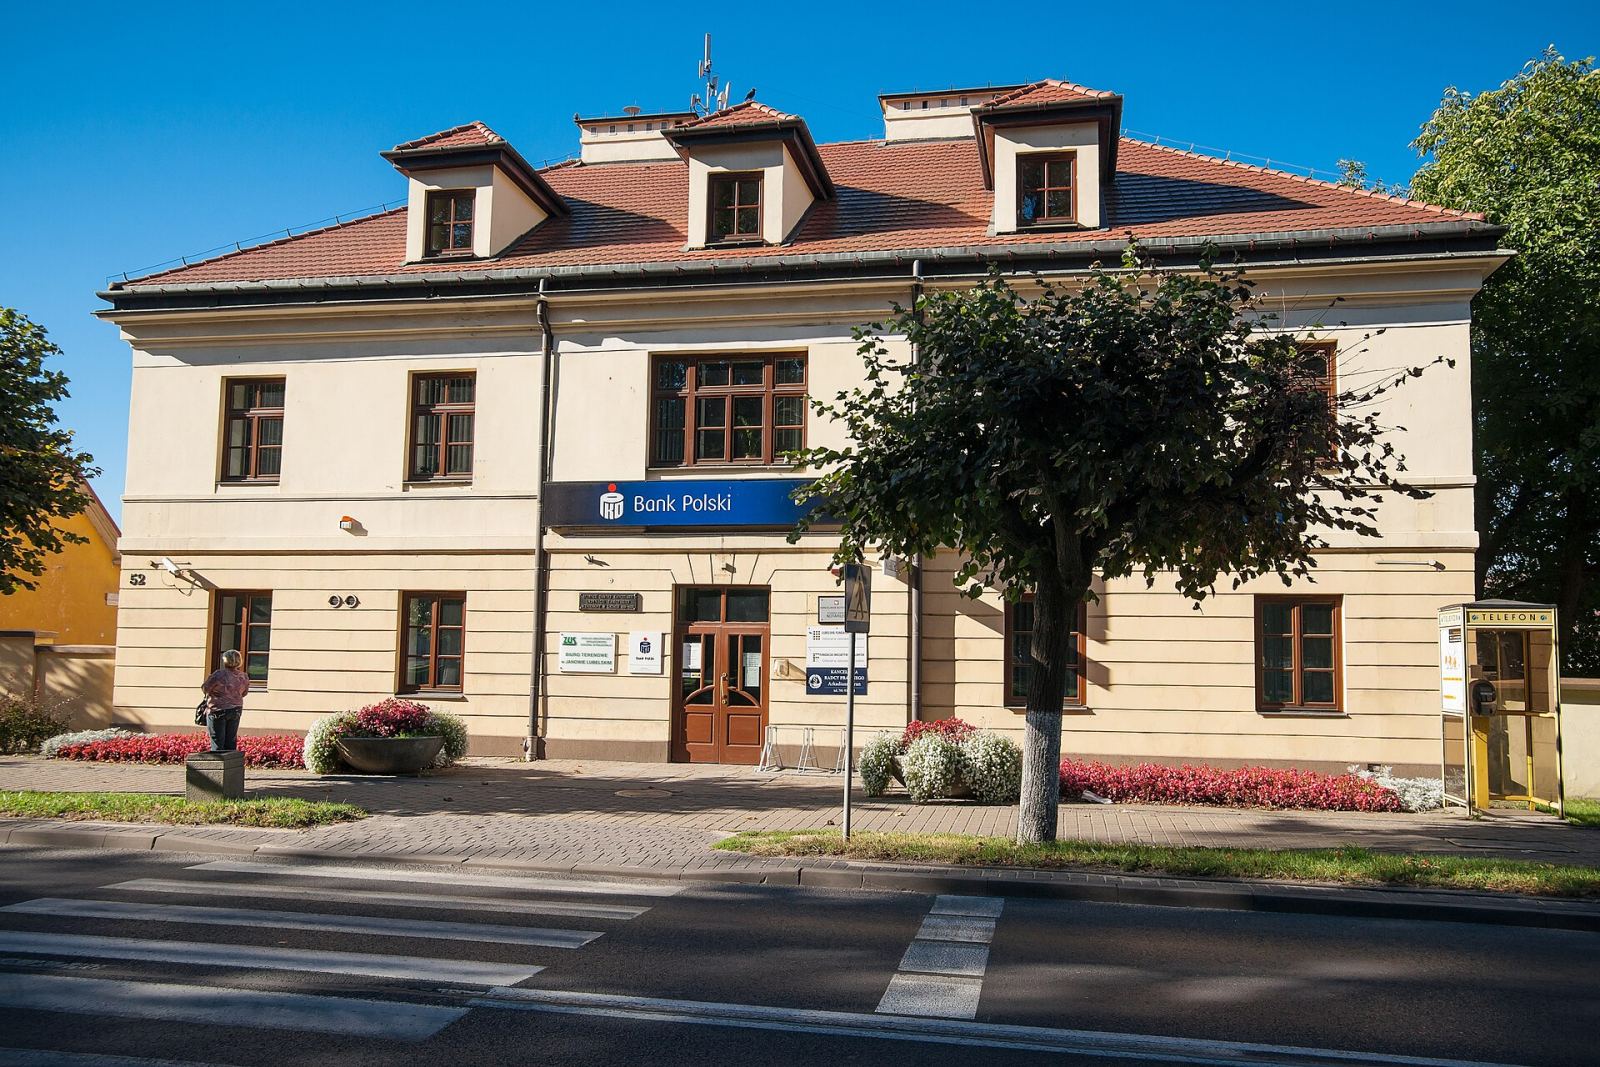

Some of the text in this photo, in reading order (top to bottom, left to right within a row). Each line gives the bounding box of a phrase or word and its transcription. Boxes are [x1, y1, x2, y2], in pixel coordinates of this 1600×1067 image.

[634, 494, 676, 512] Bank
[682, 493, 731, 512] Polski
[130, 573, 146, 586] 52
[1482, 613, 1536, 621] TELEFON
[562, 636, 577, 646] ZUS
